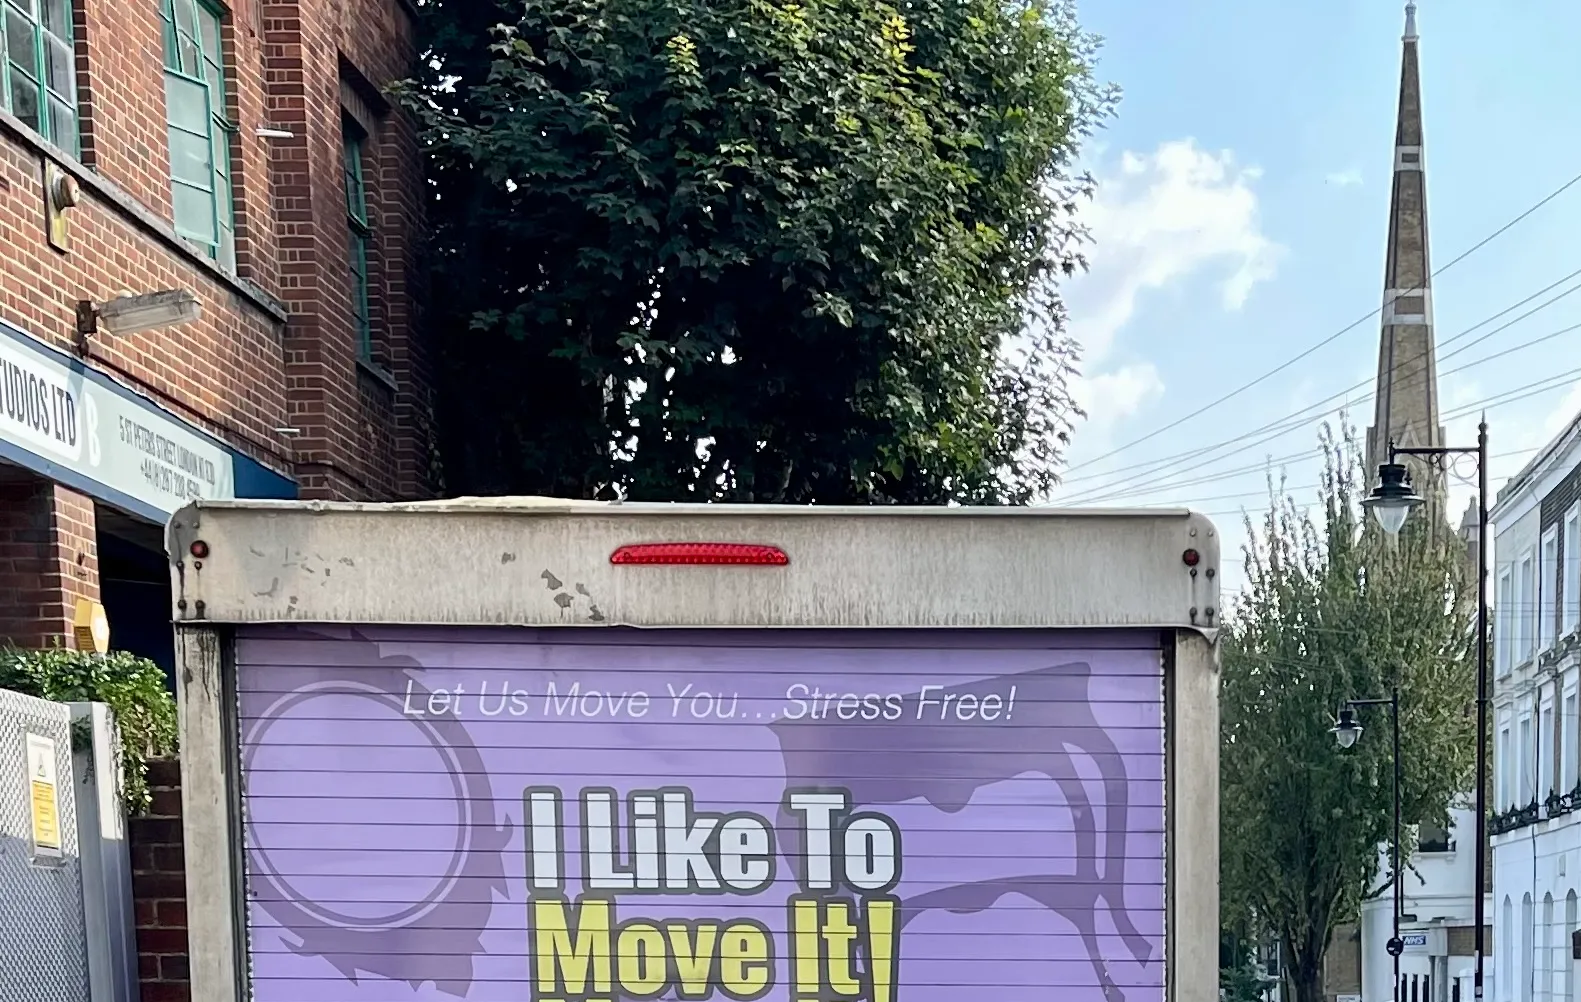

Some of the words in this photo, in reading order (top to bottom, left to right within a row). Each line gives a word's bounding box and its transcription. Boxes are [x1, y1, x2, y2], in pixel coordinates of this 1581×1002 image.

[51, 384, 76, 447] LTD
[403, 680, 463, 716] Let
[478, 680, 530, 717] Us
[544, 681, 651, 718] Move
[916, 684, 1017, 721] Free!
[527, 789, 561, 891] I
[584, 789, 773, 892] Like
[787, 790, 898, 892] To
[532, 896, 771, 997] Move
[1404, 936, 1424, 945] NHS
